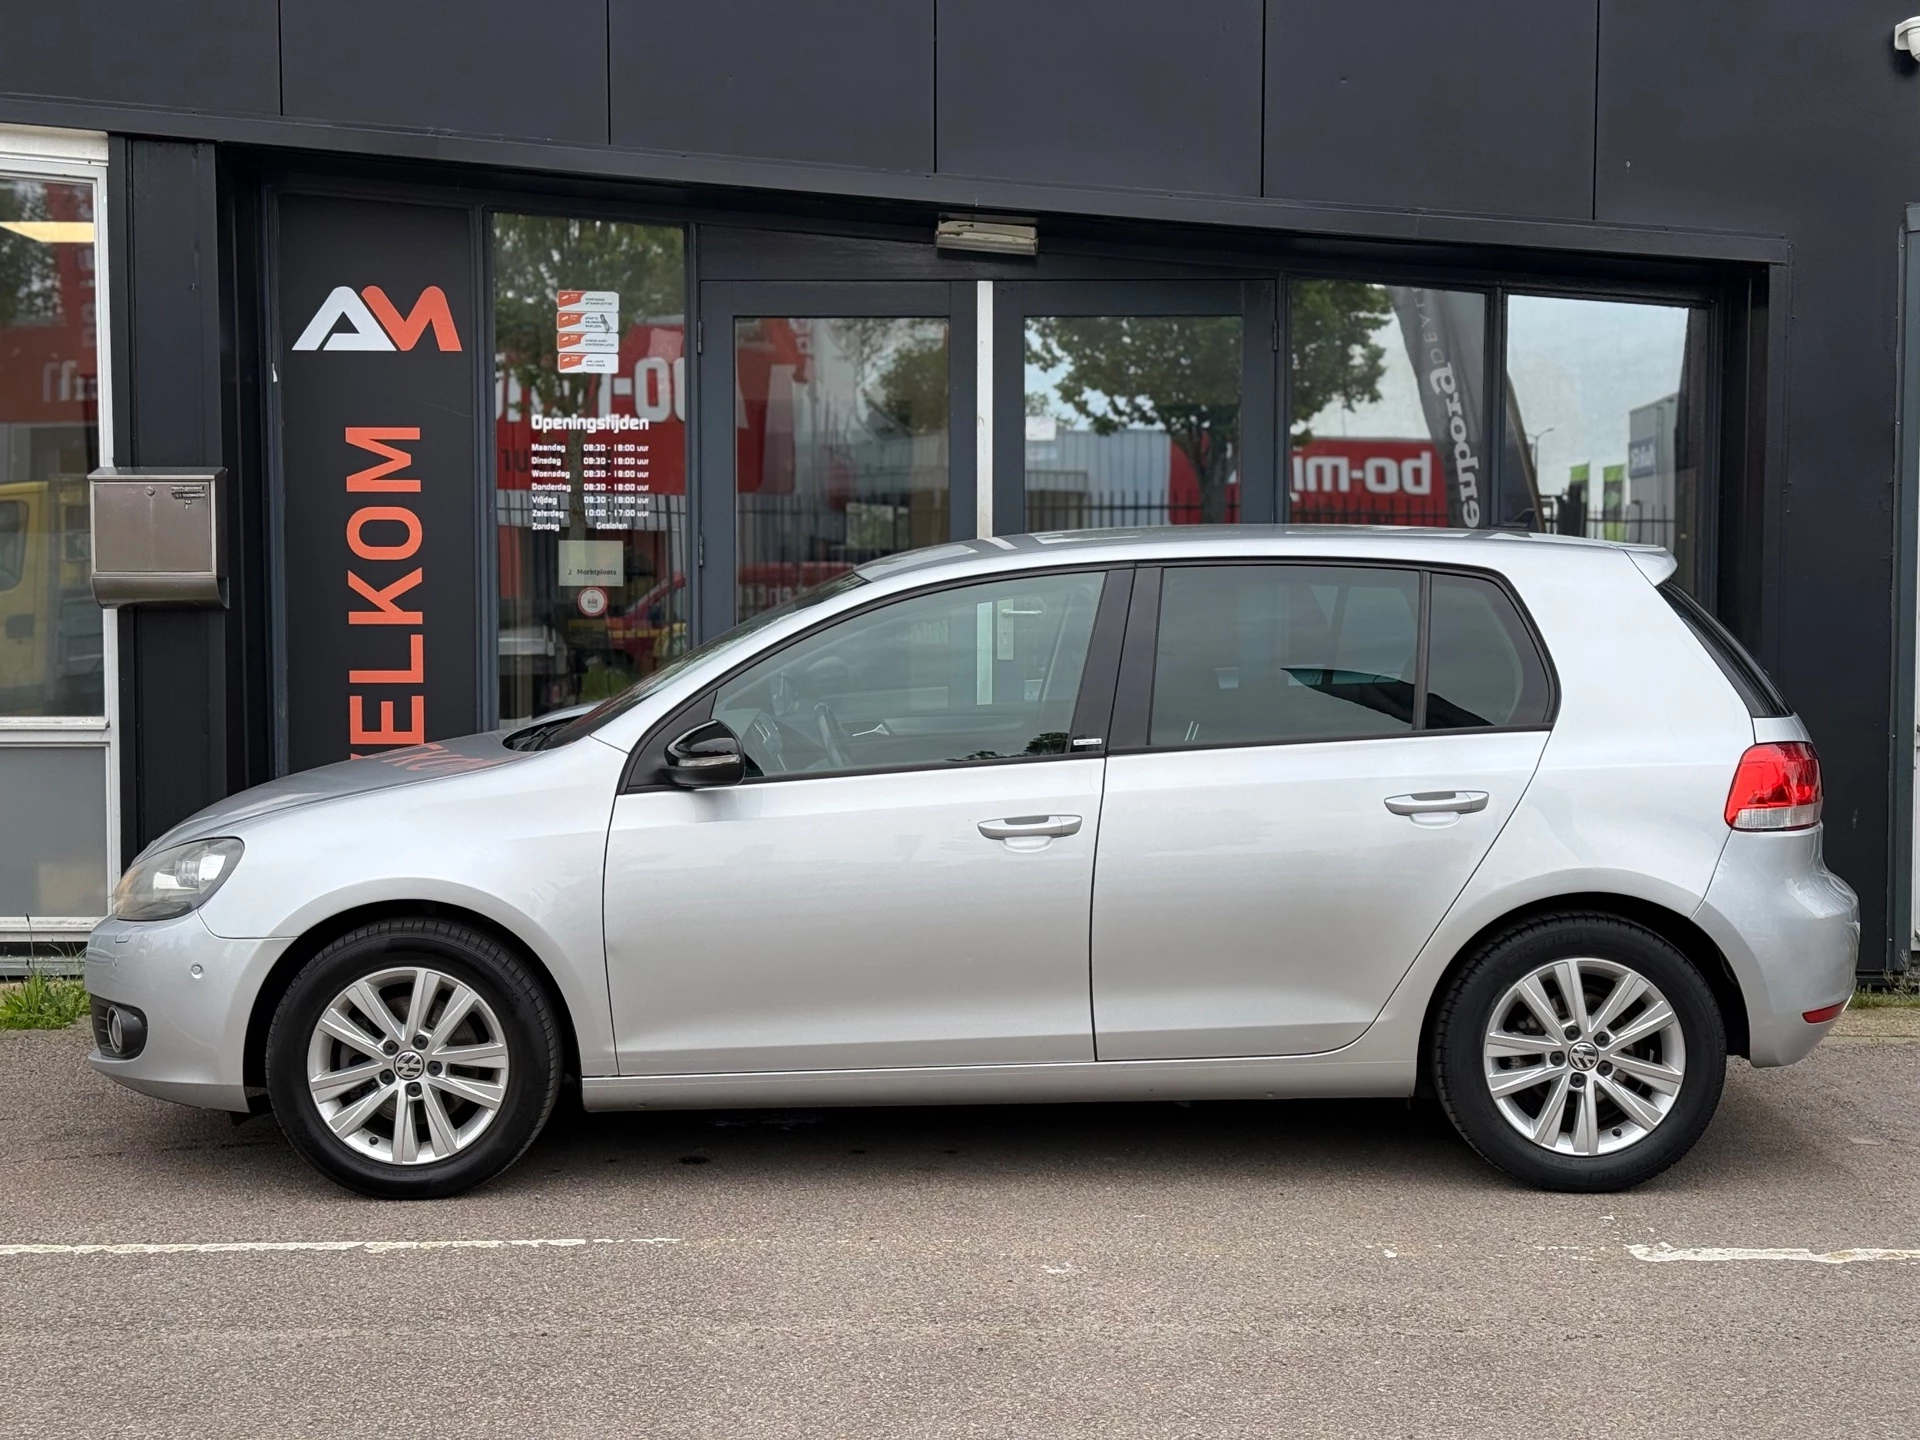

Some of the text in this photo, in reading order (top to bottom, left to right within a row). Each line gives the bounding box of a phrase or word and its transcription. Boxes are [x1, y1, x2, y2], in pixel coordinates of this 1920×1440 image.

[291, 285, 462, 351] AM
[531, 413, 649, 434] Openingstijden
[531, 444, 566, 453] Maandag
[583, 444, 607, 452] 08:30
[614, 444, 636, 452] 18:00
[531, 457, 562, 466] Dinsdag
[583, 457, 607, 465] 08:30
[614, 457, 636, 465] 18:00
[531, 470, 571, 479] Woensdag
[583, 470, 607, 478] 08:30
[614, 470, 636, 478] 18:00
[531, 483, 572, 492] Donderdag
[583, 483, 607, 491] 08:30
[614, 483, 636, 491] 18:00
[531, 496, 558, 505] Vrijdag
[583, 496, 607, 504] 08:30
[614, 496, 636, 504] 18:00
[531, 509, 564, 518] Zaterdag
[585, 509, 607, 517] 10:00
[614, 509, 636, 517] 17:00
[532, 521, 628, 532] Zondag Gesloten
[346, 427, 425, 761] ELKOM
